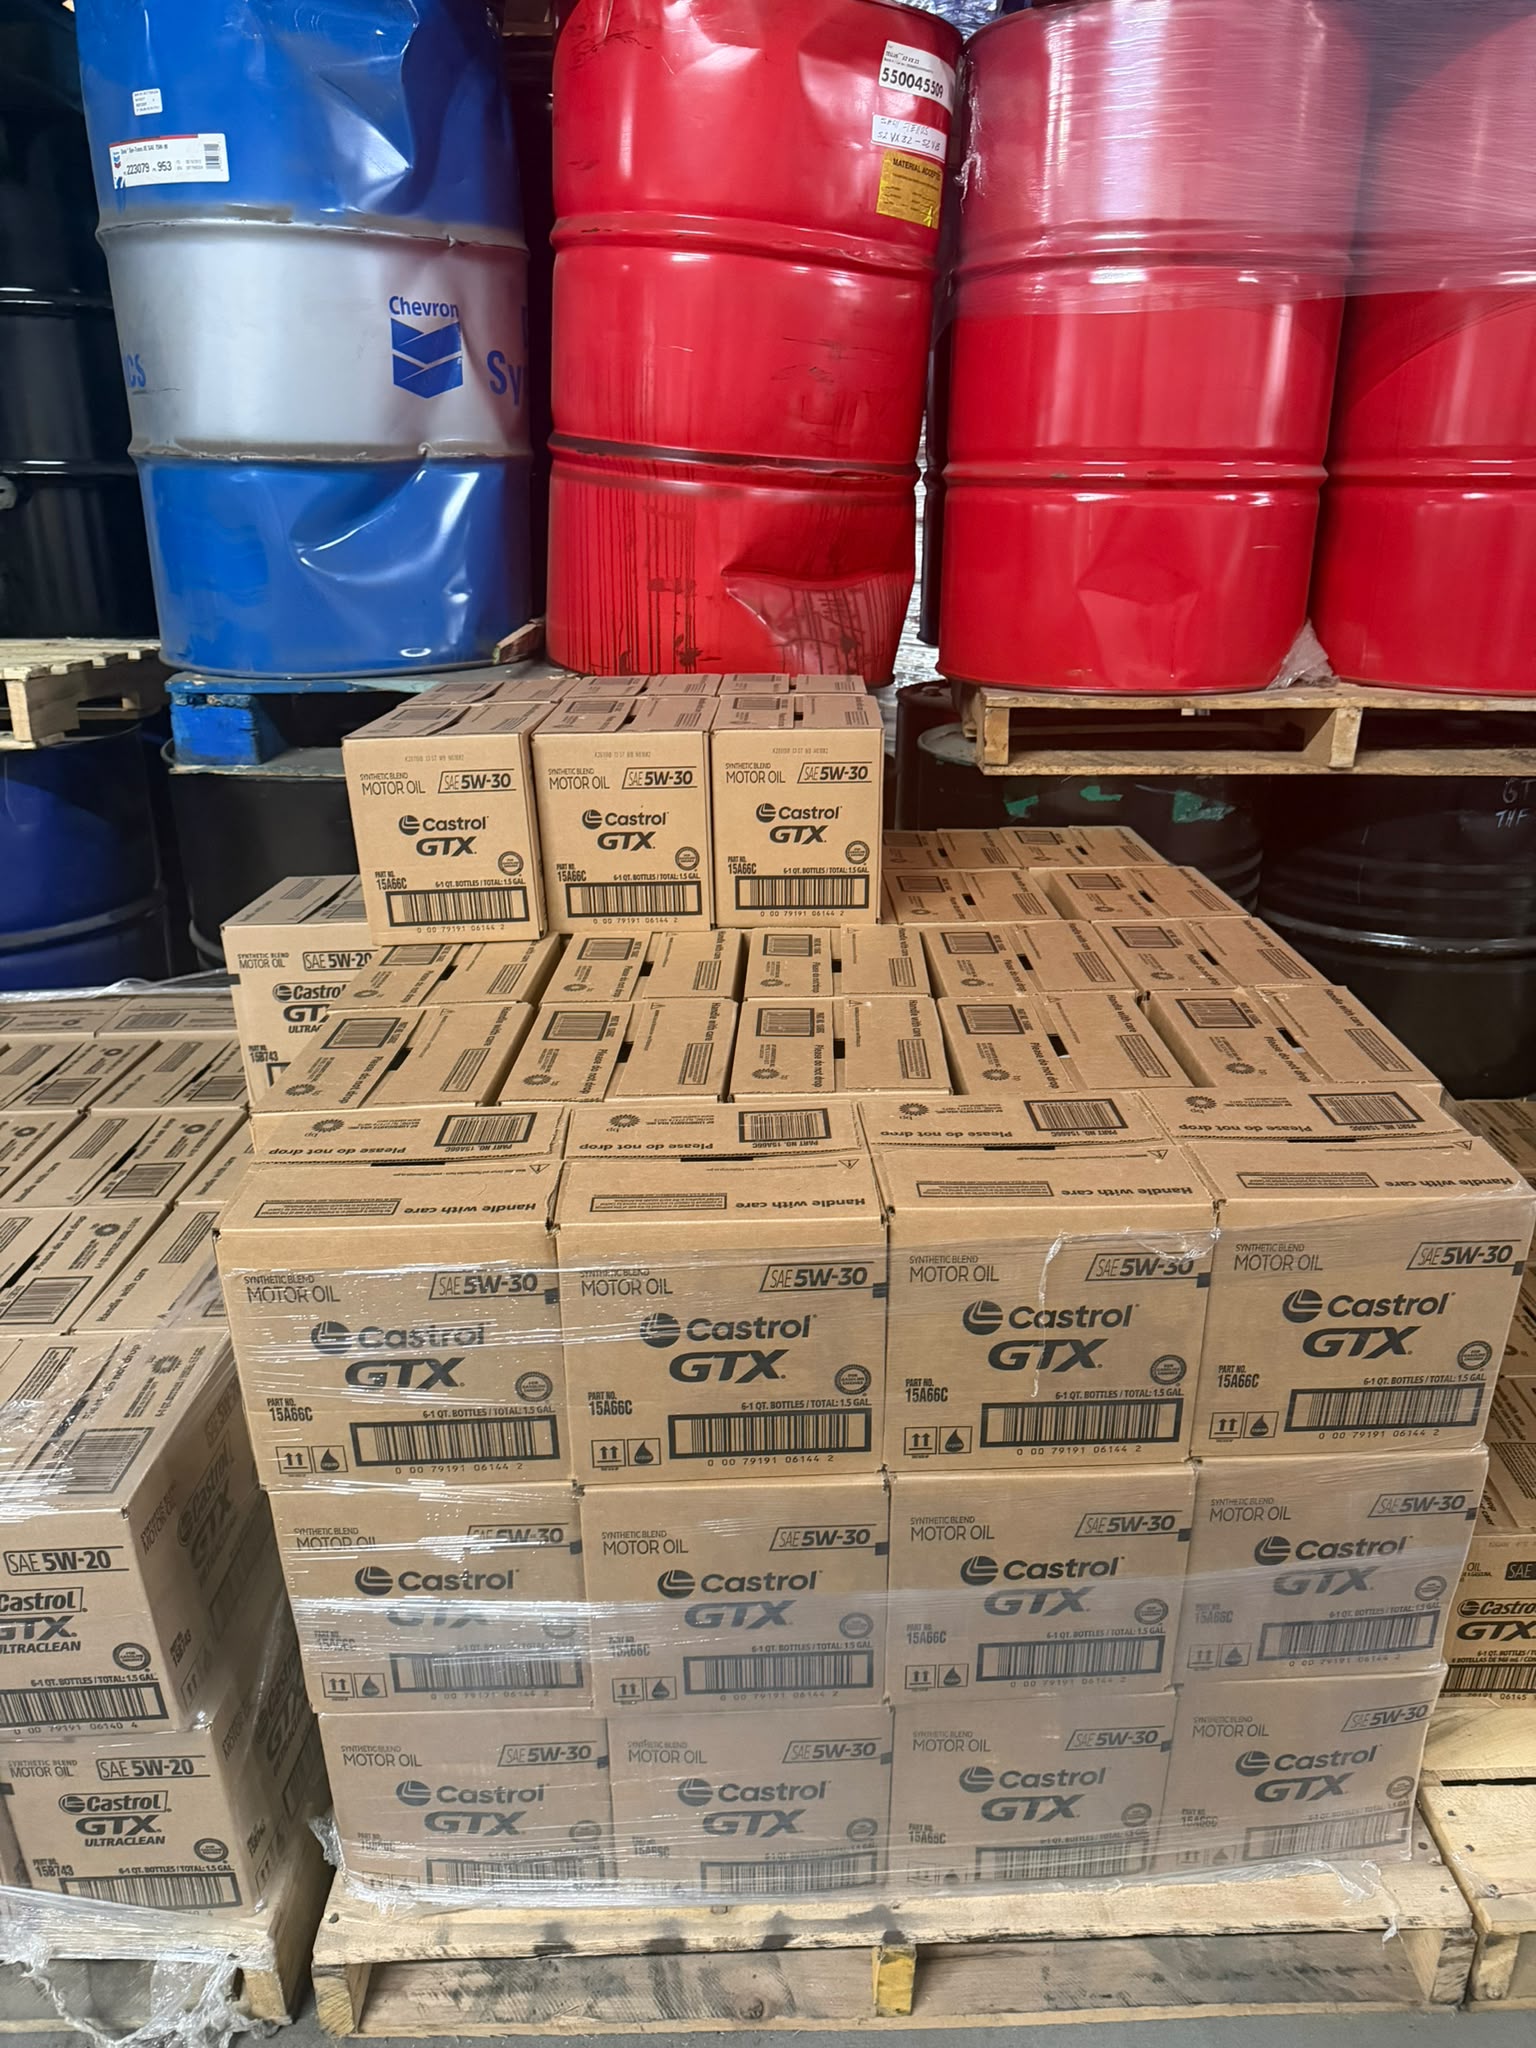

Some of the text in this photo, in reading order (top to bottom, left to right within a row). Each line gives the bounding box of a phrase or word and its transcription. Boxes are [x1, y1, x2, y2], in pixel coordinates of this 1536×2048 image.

[126, 164, 150, 176] 223079
[157, 161, 172, 172] 953
[893, 158, 920, 172] MATERIAL
[389, 296, 460, 317] Chevron
[360, 772, 408, 781] SYNTHETIC BLEND
[444, 773, 511, 790] SAE 5W-30
[628, 770, 693, 786] SAE 5W-30
[726, 770, 786, 784] MOTOR OIL
[804, 765, 868, 781] SAE 5W-30
[362, 780, 426, 796] MOTOR OIL
[549, 776, 610, 790] MOTOR OIL
[605, 812, 667, 826] Castrol
[778, 806, 839, 820] Castrol
[422, 816, 486, 832] Castrol
[598, 831, 656, 851] GTX
[769, 825, 828, 845] GTX
[416, 836, 477, 857] GTX
[558, 870, 586, 882] 15A66C
[728, 864, 756, 874] 15A66C
[376, 878, 407, 890] 15A66C
[238, 958, 286, 968] MOTOR OIL
[304, 954, 326, 968] SAE
[292, 985, 346, 1000] Castro
[268, 1148, 303, 1156] drop
[440, 1205, 476, 1213] with
[482, 1202, 536, 1212] Handle
[1236, 1244, 1278, 1252] SYNTHETIC
[1418, 1245, 1513, 1266] SAE 5W-30
[909, 1255, 978, 1264] SYNTHETIC BLEND
[1096, 1257, 1194, 1277] SAE 5W-30
[1234, 1254, 1324, 1271] MOTOR OIL
[244, 1276, 314, 1284] SYNTHETIC BLEND
[770, 1266, 868, 1288] SAE 5W-30
[909, 1265, 1000, 1282] MOTOR OIL
[439, 1273, 538, 1296] SAE 5W-30
[581, 1278, 673, 1297] MOTOR OIL
[247, 1285, 340, 1304] MOTOR OIL
[1328, 1293, 1450, 1318] Castrol
[1008, 1304, 1133, 1329] Castrol
[358, 1322, 484, 1349] Castrol
[686, 1314, 811, 1342] Castrol
[1302, 1326, 1423, 1360] GTX
[988, 1338, 1108, 1373] GTX
[345, 1357, 466, 1392] GTX
[668, 1350, 790, 1384] GTX
[1218, 1374, 1260, 1388] 15A66C
[906, 1387, 948, 1402] 15A66C
[590, 1400, 632, 1416] 15A66C
[741, 1402, 754, 1410] 6-1
[755, 1402, 768, 1410] QT.
[770, 1400, 804, 1410] BOTTLES
[810, 1398, 839, 1408] TOTAL:
[840, 1398, 851, 1407] 1.5
[852, 1398, 872, 1406] GAL.
[270, 1407, 313, 1422] 15A66C
[722, 1458, 736, 1466] 00
[742, 1457, 777, 1465] 79191
[785, 1456, 820, 1464] 06144
[1378, 1497, 1399, 1513] SAE
[1400, 1495, 1466, 1512] 5W-30
[1210, 1506, 1291, 1522] MOTOR OIL
[1086, 1515, 1175, 1534] SAE 5W-30
[779, 1529, 870, 1547] SAE 5W-30
[910, 1525, 994, 1542] MOTOR OIL
[602, 1539, 688, 1555] MOTOR OIL
[1296, 1536, 1406, 1561] Castrol
[8, 1550, 112, 1573] SAE 5W-20
[1003, 1557, 1119, 1580] Castrol
[398, 1569, 514, 1590] Castrol
[1508, 1563, 1532, 1579] SAE
[701, 1570, 817, 1593] Castrol
[1273, 1566, 1380, 1596] GTX
[984, 1586, 1096, 1616] GTX
[1479, 1601, 1536, 1617] Castro
[684, 1600, 796, 1630] GTX
[907, 1631, 947, 1645] 15A66C
[1457, 1621, 1534, 1641] GTX
[1370, 1705, 1429, 1726] 5W-30
[1095, 1730, 1158, 1746] 5W-30
[527, 1746, 592, 1763] 5W-30
[812, 1742, 876, 1759] 5W-30
[1274, 1745, 1376, 1772] Castrol
[10, 1766, 74, 1778] MOTOR OIL
[100, 1759, 194, 1778] SAE 5W-20
[1000, 1768, 1106, 1790] Castrol
[1254, 1772, 1354, 1802] GTX
[436, 1784, 544, 1804] Castrol
[718, 1780, 826, 1802] Castrol
[86, 1794, 161, 1814] Castrol
[981, 1794, 1084, 1822] GTX
[76, 1815, 160, 1836] GTX
[424, 1811, 526, 1836] GTX
[702, 1810, 806, 1838] GTX
[84, 1836, 166, 1848] ULTRACLEAN
